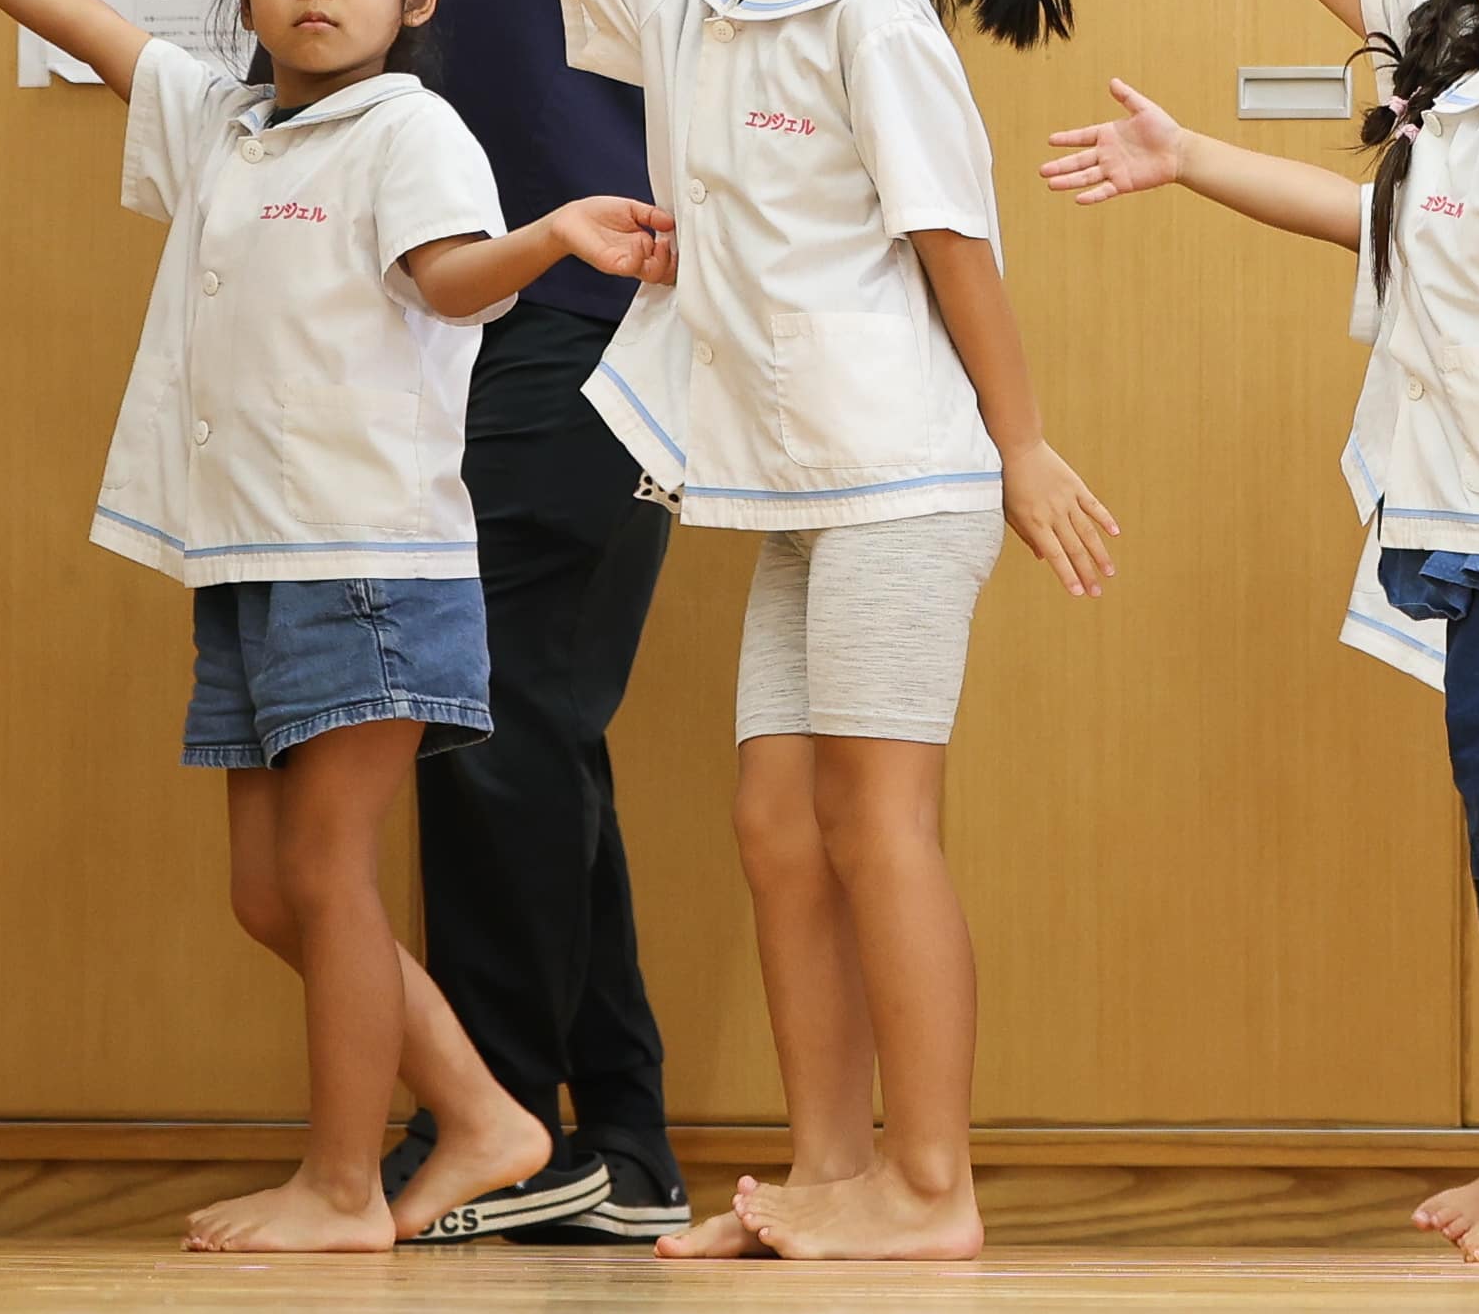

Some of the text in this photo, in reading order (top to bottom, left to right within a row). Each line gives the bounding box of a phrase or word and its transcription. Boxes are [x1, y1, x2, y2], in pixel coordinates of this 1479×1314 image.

[744, 111, 816, 136] エンジェル
[259, 202, 328, 223] エンジェル
